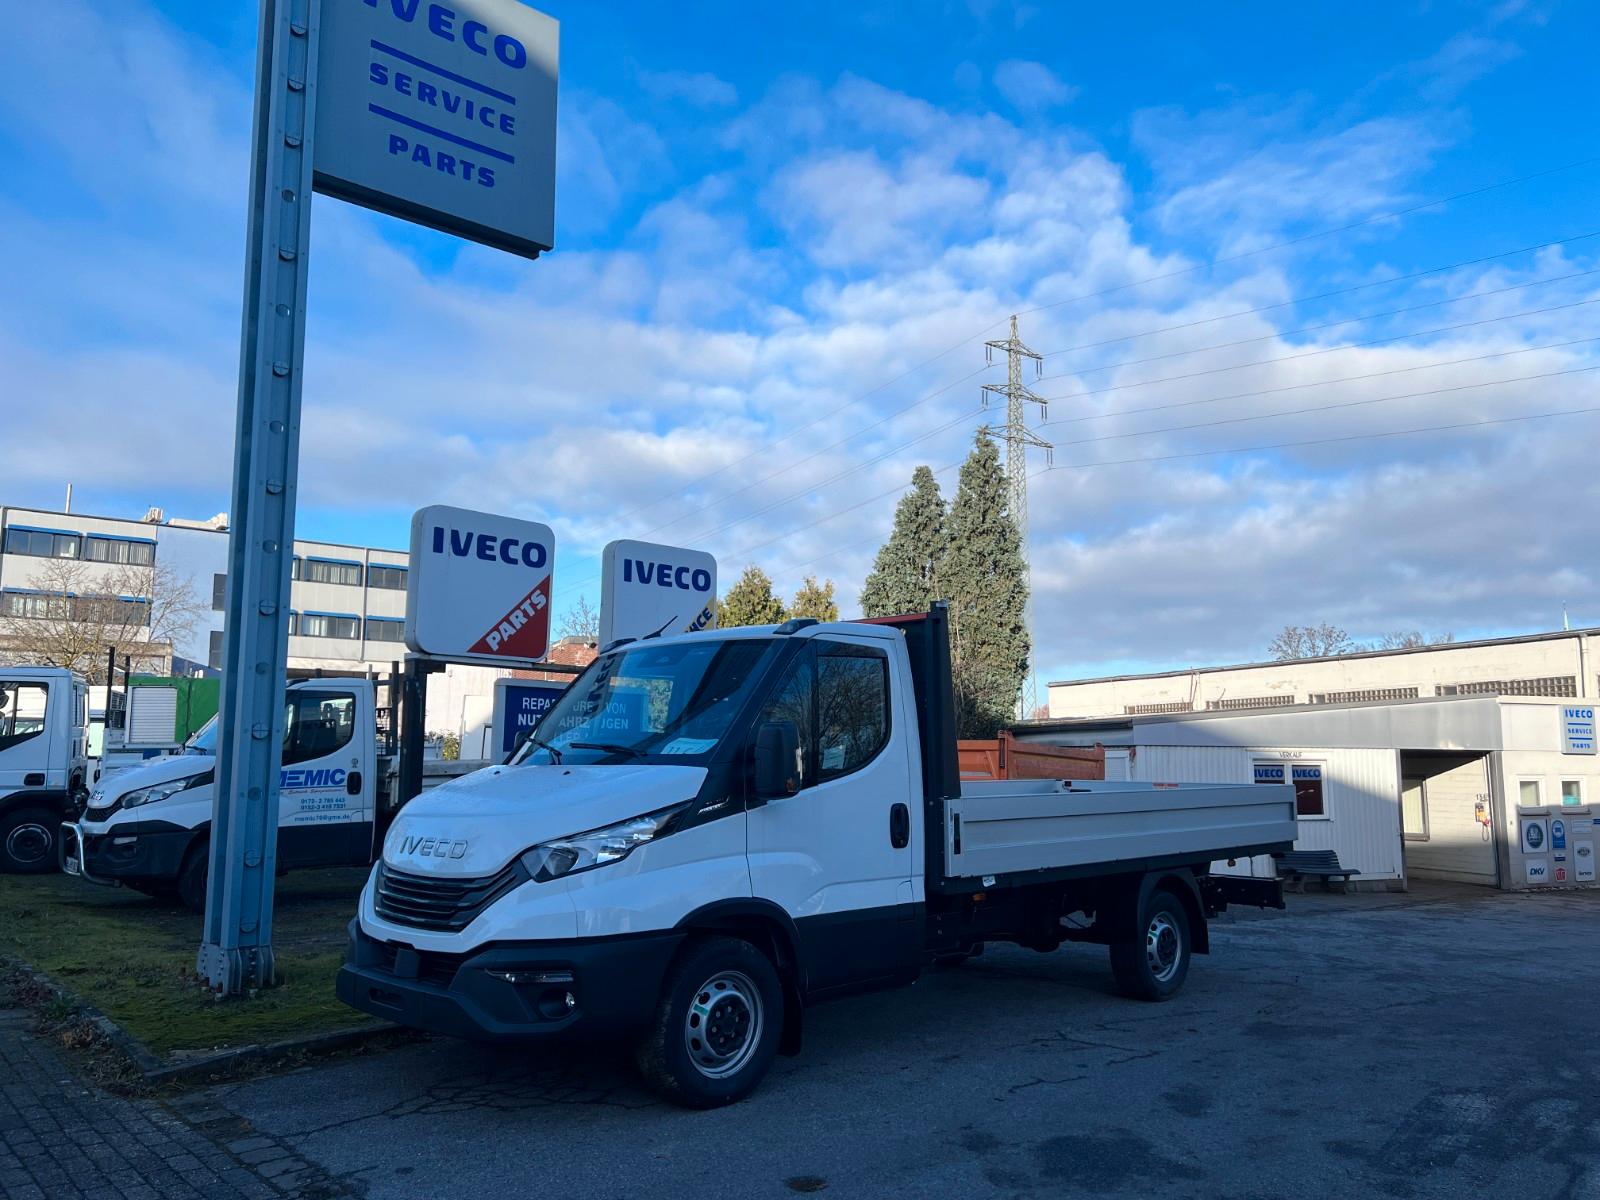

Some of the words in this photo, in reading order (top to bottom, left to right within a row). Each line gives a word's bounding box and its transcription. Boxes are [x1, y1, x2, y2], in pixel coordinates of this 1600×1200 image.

[363, 0, 527, 69] VECO
[369, 62, 516, 136] SERVICE
[389, 133, 496, 189] PARTS
[432, 526, 547, 569] IVECO
[623, 558, 712, 592] IVECO
[486, 588, 547, 652] PARTS
[606, 702, 627, 714] VON
[1564, 708, 1593, 719] IVECO
[1254, 768, 1284, 778] IVECO
[1292, 768, 1321, 778] IVECO
[399, 835, 469, 860] IVECO
[1529, 867, 1545, 876] DKV
